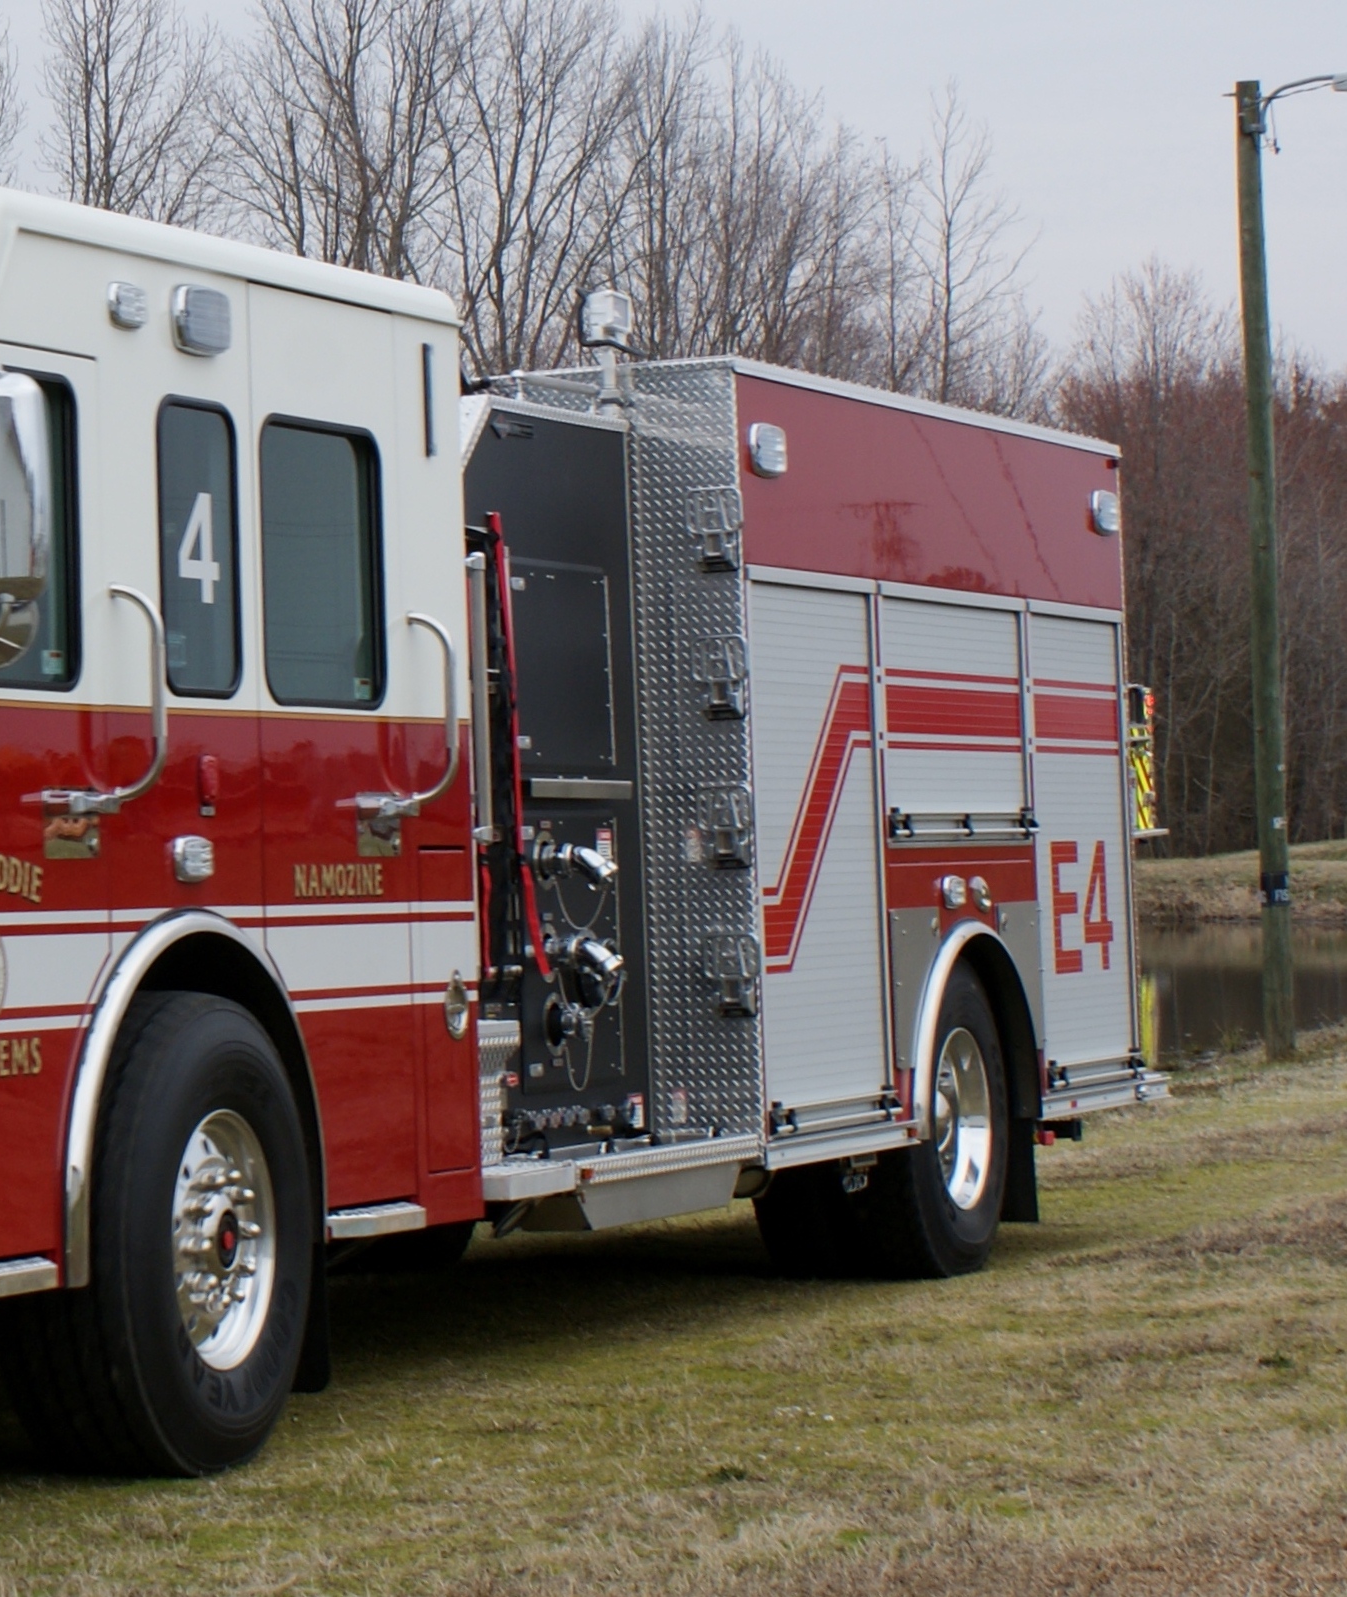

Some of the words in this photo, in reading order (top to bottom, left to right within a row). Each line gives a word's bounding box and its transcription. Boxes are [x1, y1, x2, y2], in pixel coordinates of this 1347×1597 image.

[178, 493, 220, 604] 4
[294, 863, 384, 898] NAMOZINE
[1049, 840, 1114, 974] E4
